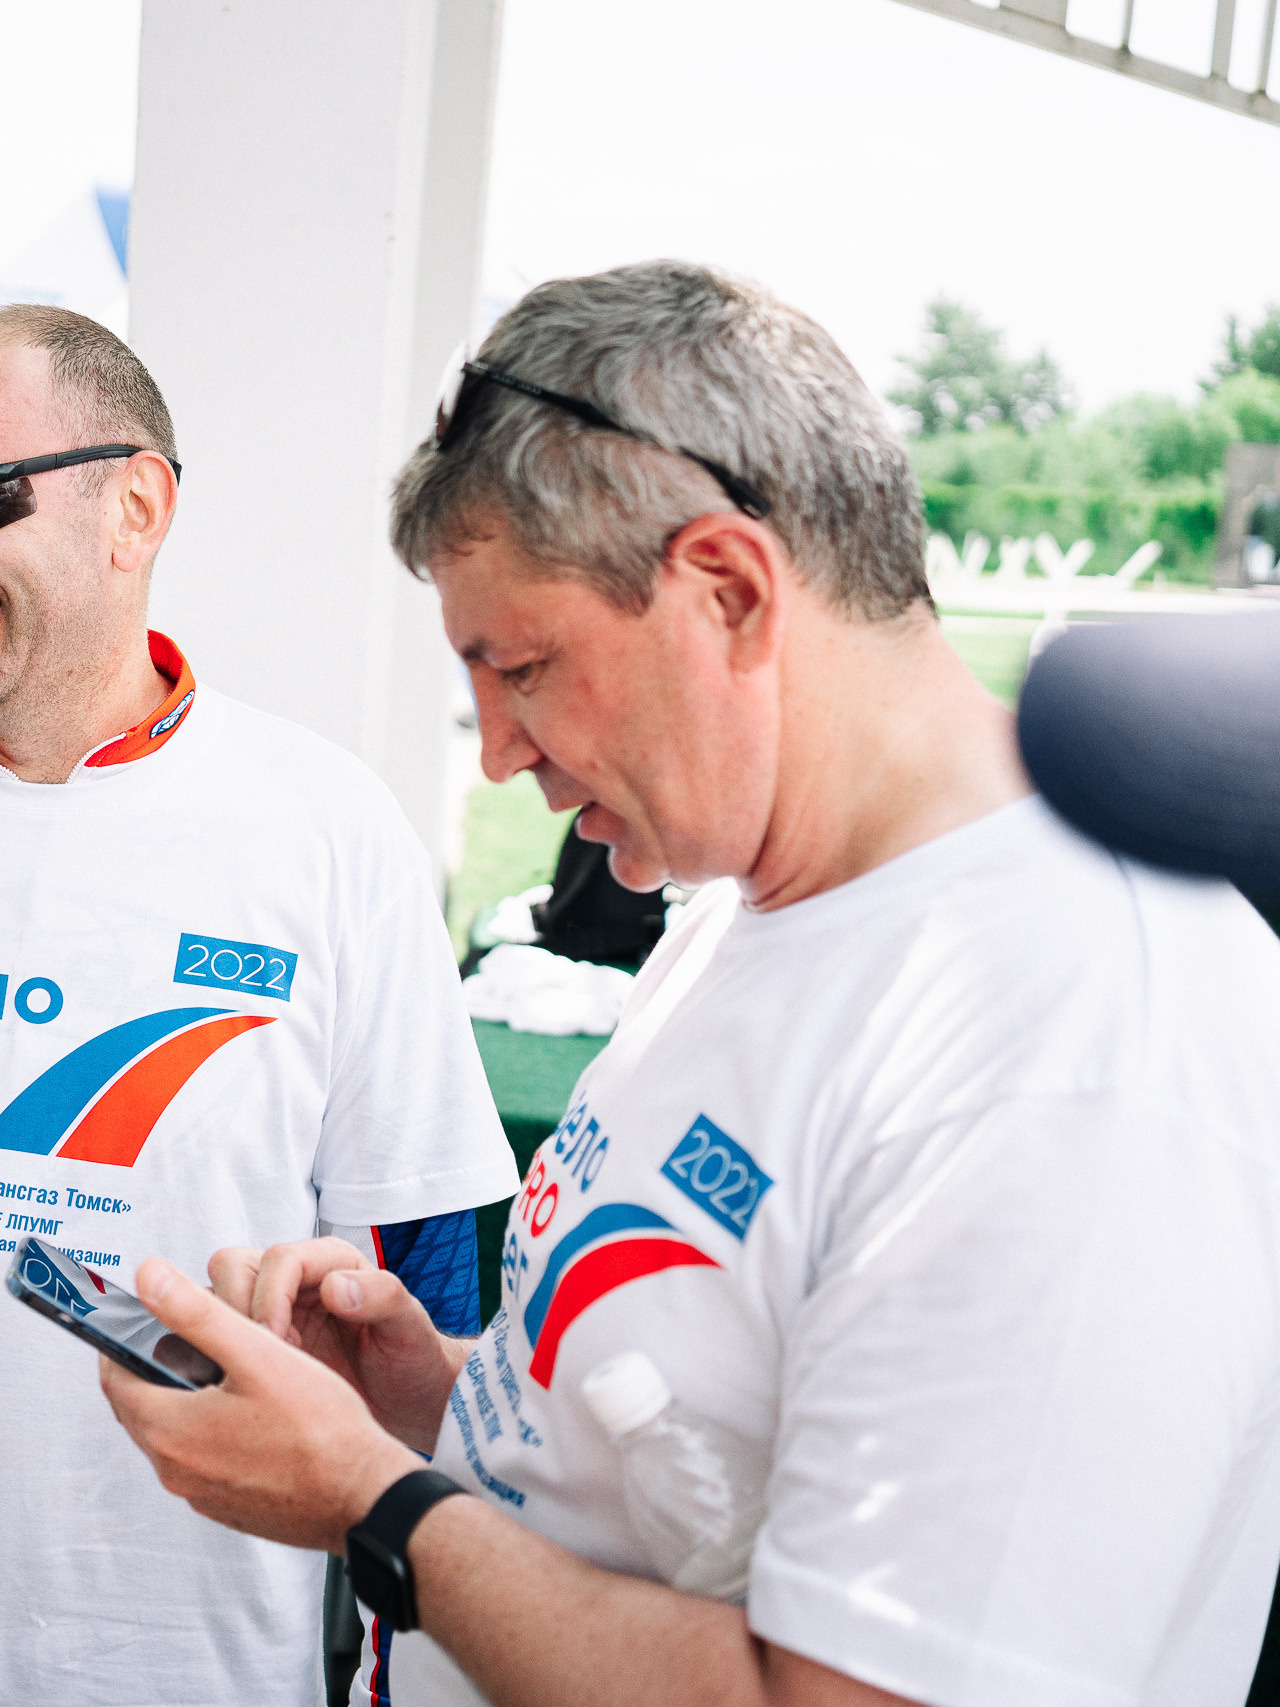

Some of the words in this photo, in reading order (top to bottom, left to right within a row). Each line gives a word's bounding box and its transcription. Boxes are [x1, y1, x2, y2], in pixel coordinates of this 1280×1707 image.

[182, 943, 288, 992] 2022
[670, 1127, 760, 1229] 2022
[65, 1187, 132, 1215] Томск»
[5, 1215, 63, 1236] ЛПУМГ
